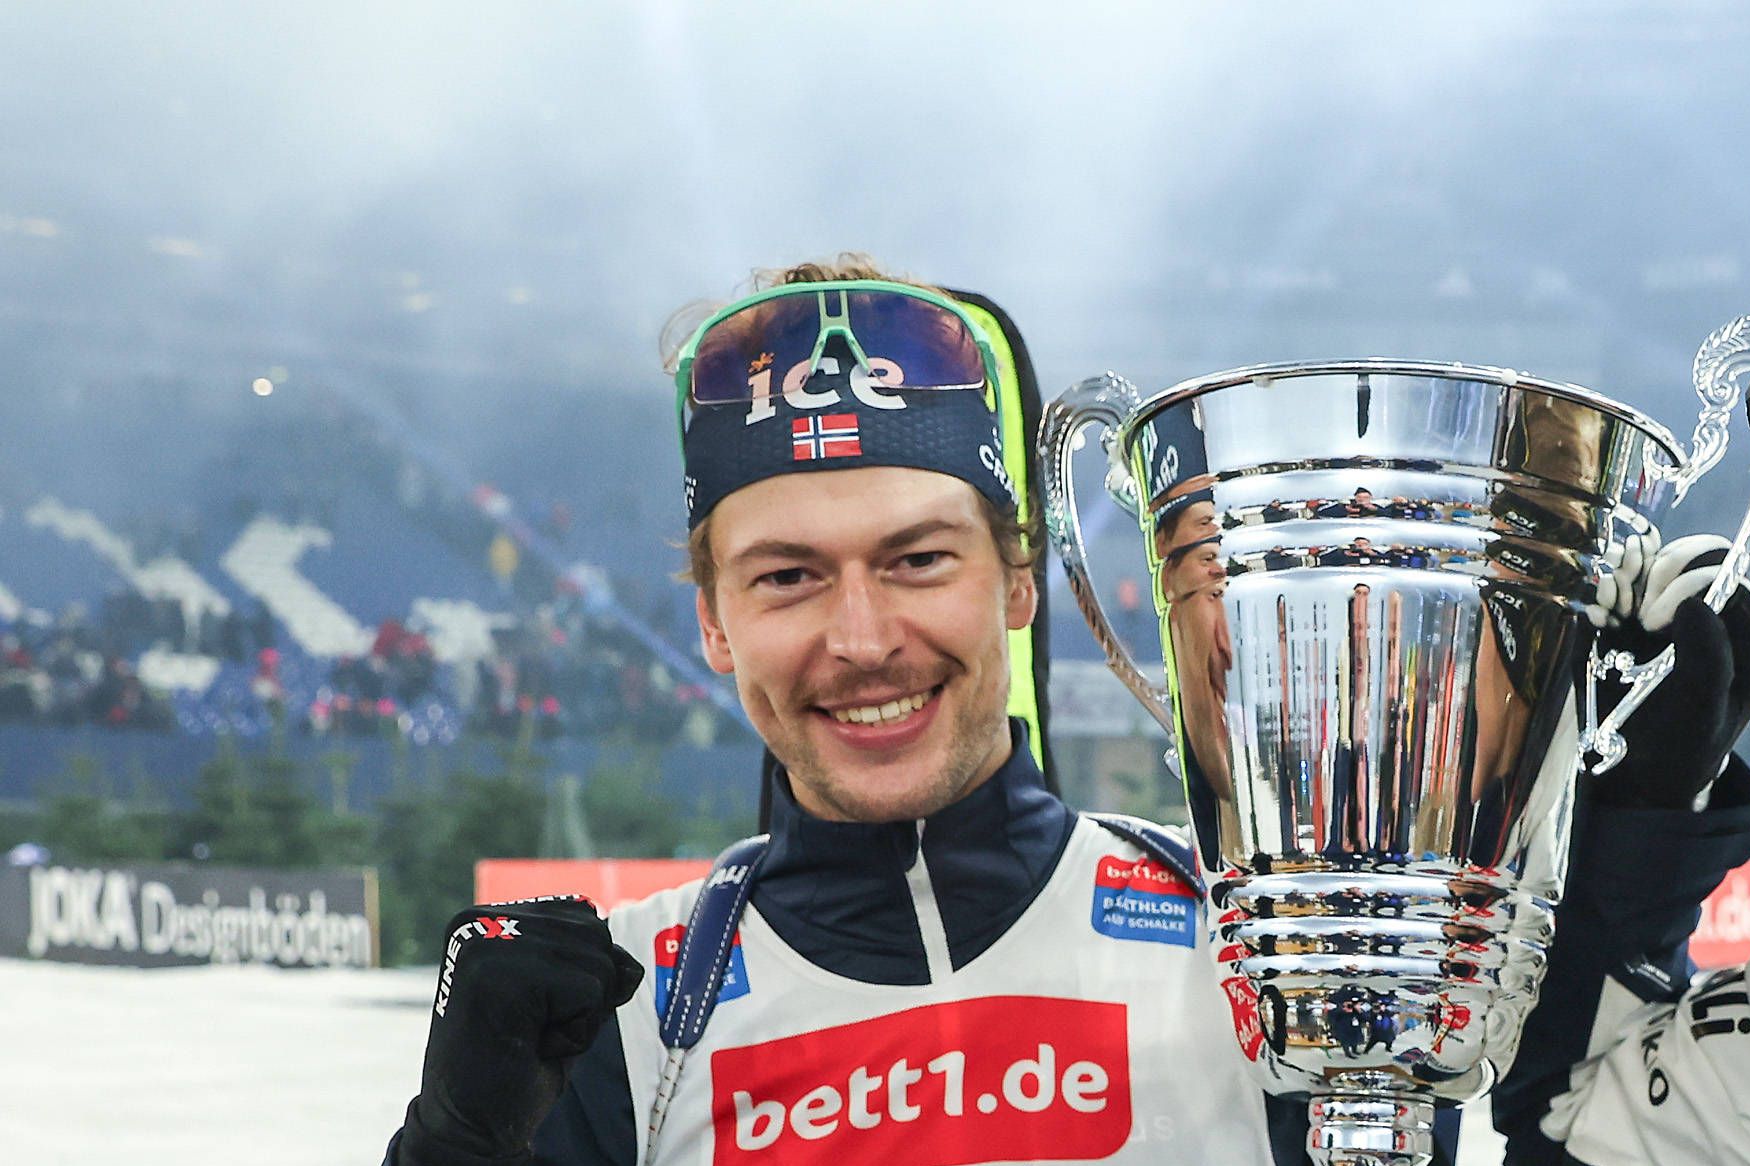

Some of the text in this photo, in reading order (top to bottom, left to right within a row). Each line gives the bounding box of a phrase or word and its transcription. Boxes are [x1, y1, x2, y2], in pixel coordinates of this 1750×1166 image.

[745, 352, 907, 425] ice
[27, 866, 371, 968] JOKA Designböden
[1103, 895, 1186, 916] BIATHLON
[1128, 917, 1186, 932] SCHALKE
[733, 1044, 1110, 1152] bett1.de
